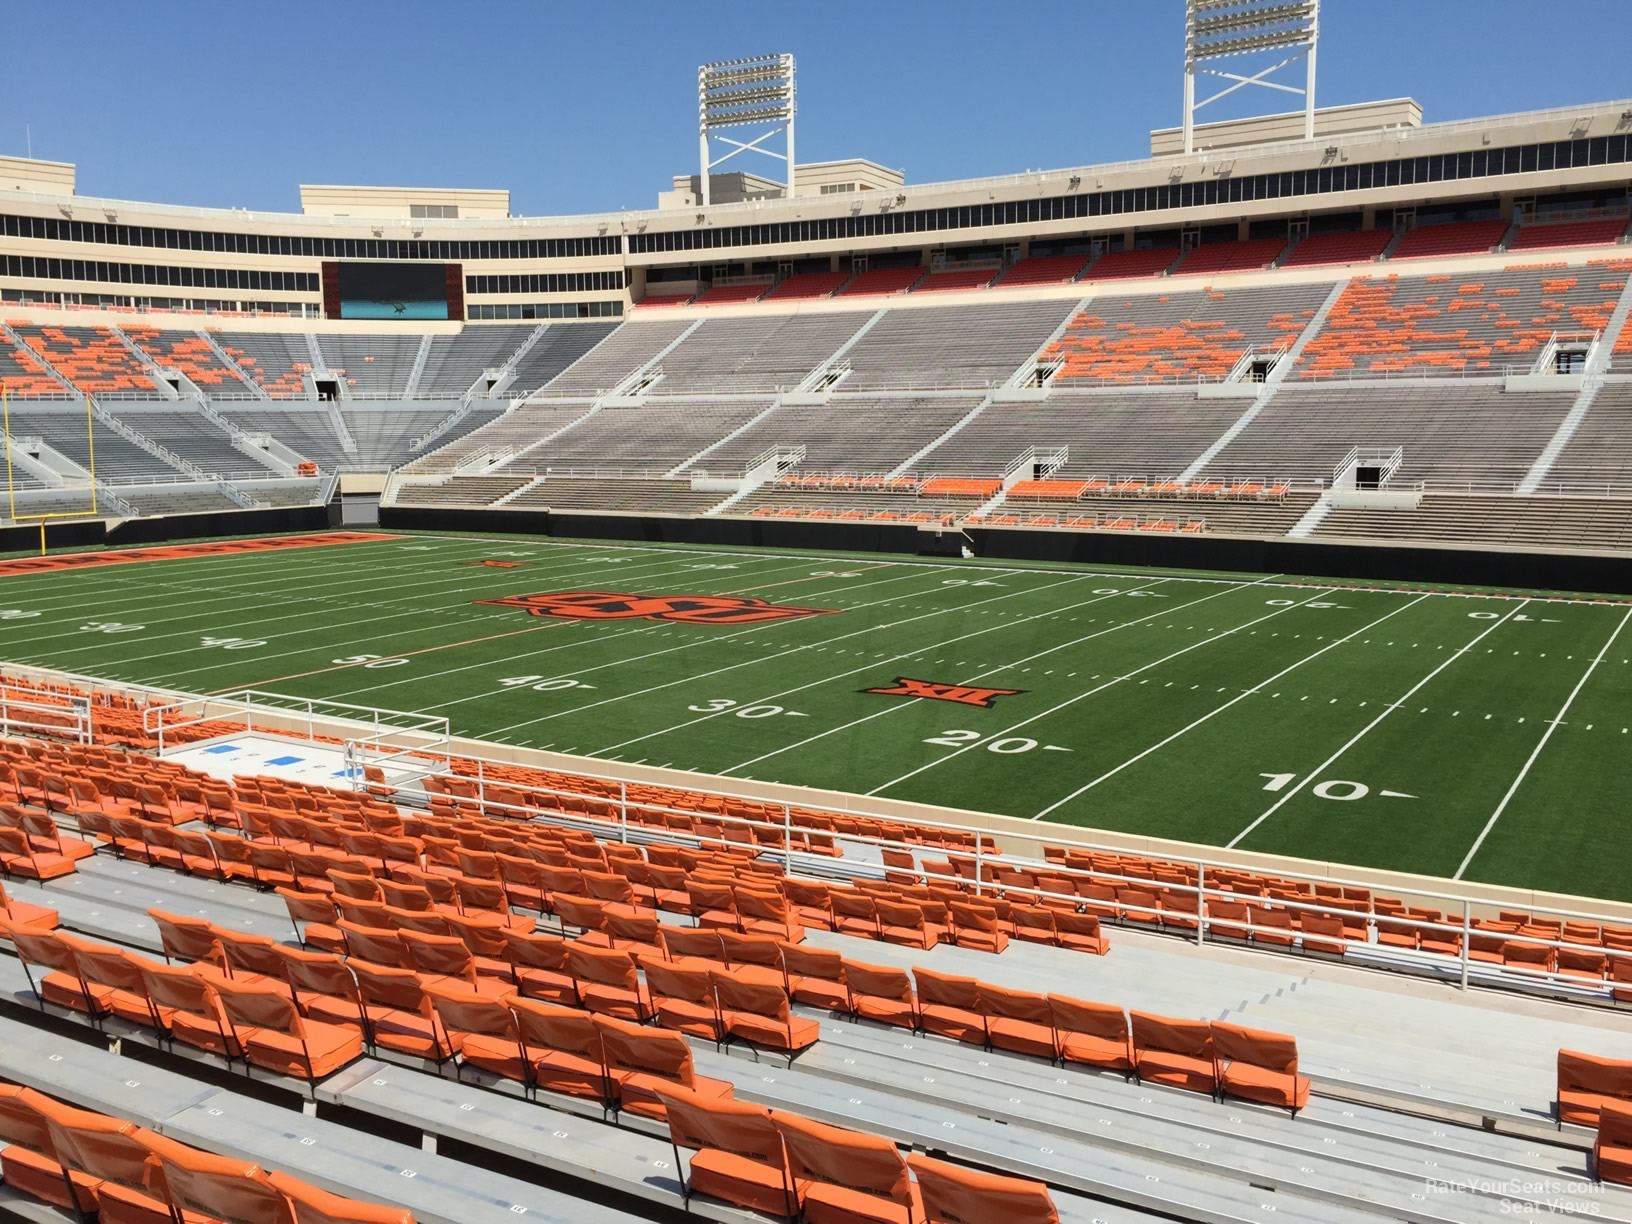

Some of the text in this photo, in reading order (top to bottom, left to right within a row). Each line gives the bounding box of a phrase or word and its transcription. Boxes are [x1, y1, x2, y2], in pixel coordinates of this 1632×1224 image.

[80, 621, 146, 634] 30
[200, 636, 268, 650] 40
[331, 654, 410, 670] 50
[497, 675, 579, 691] 40
[688, 699, 783, 719] 30
[923, 729, 1040, 755] 20
[1259, 771, 1370, 802] 10
